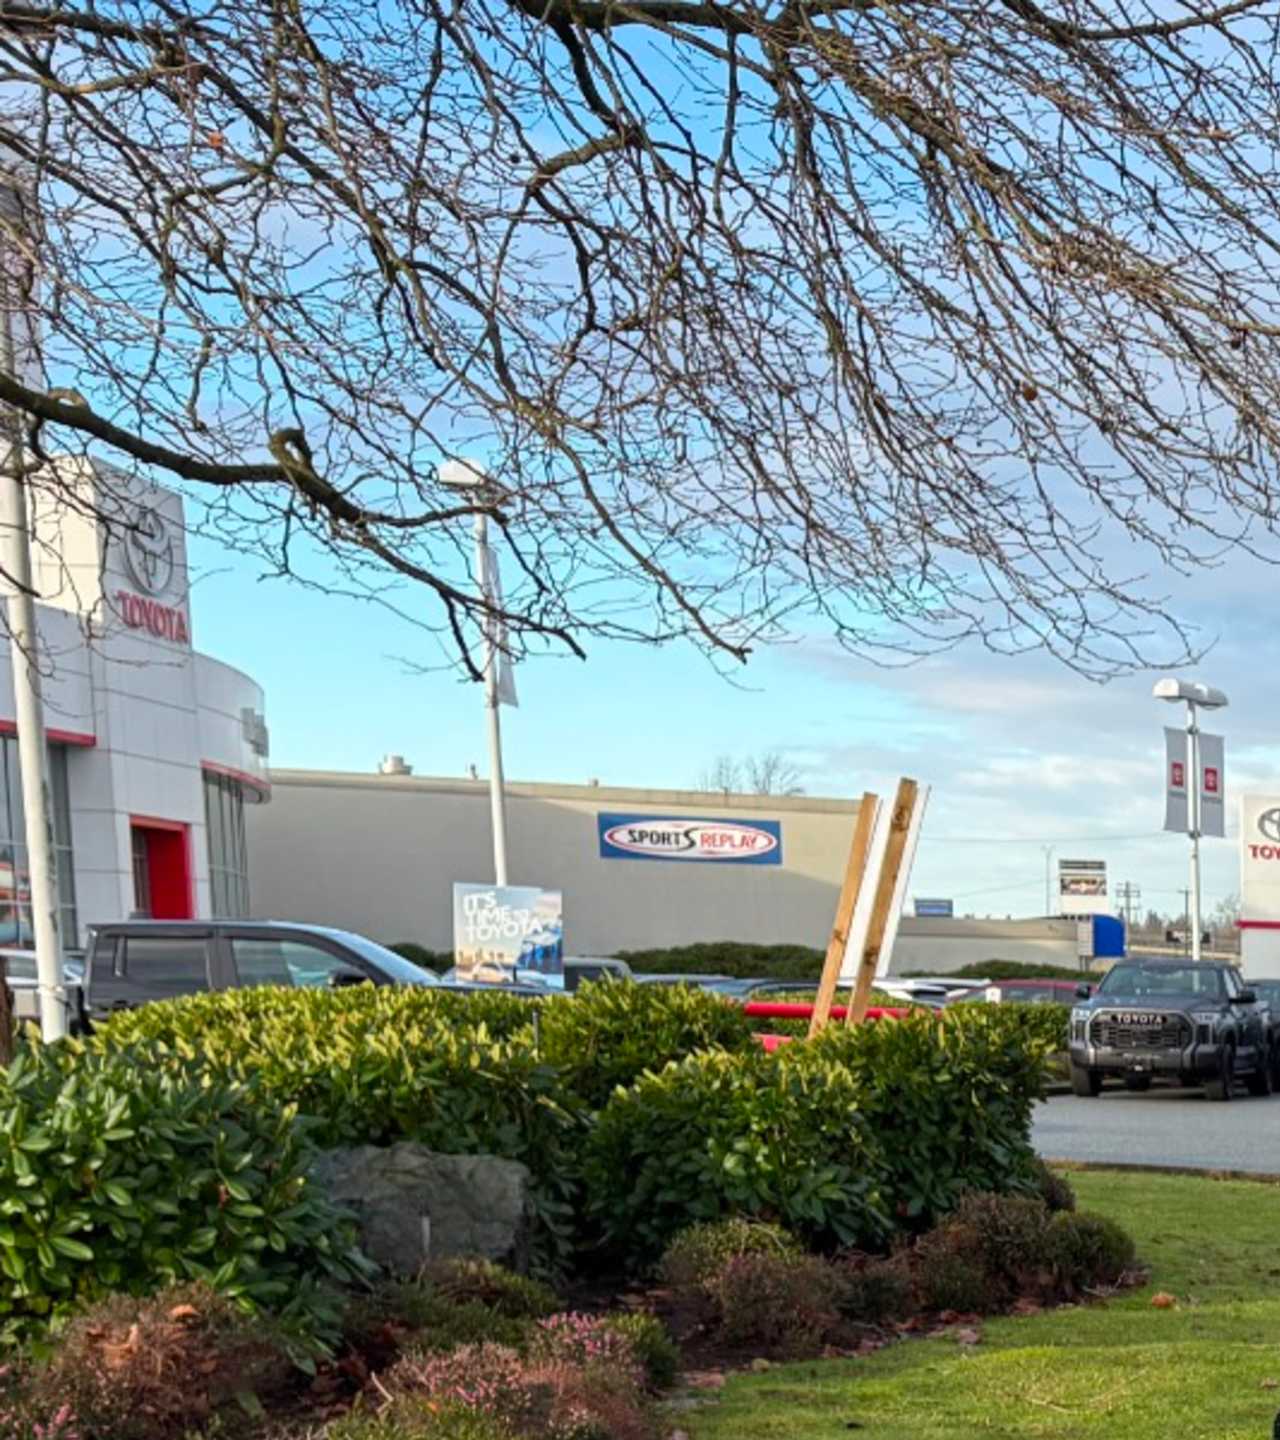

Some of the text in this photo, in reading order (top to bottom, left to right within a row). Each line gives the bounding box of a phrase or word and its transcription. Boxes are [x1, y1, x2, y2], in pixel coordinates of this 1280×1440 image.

[116, 590, 189, 644] TOYOTA
[628, 827, 759, 851] SPORTS REPLAY
[1117, 1012, 1163, 1024] TOYOTA
